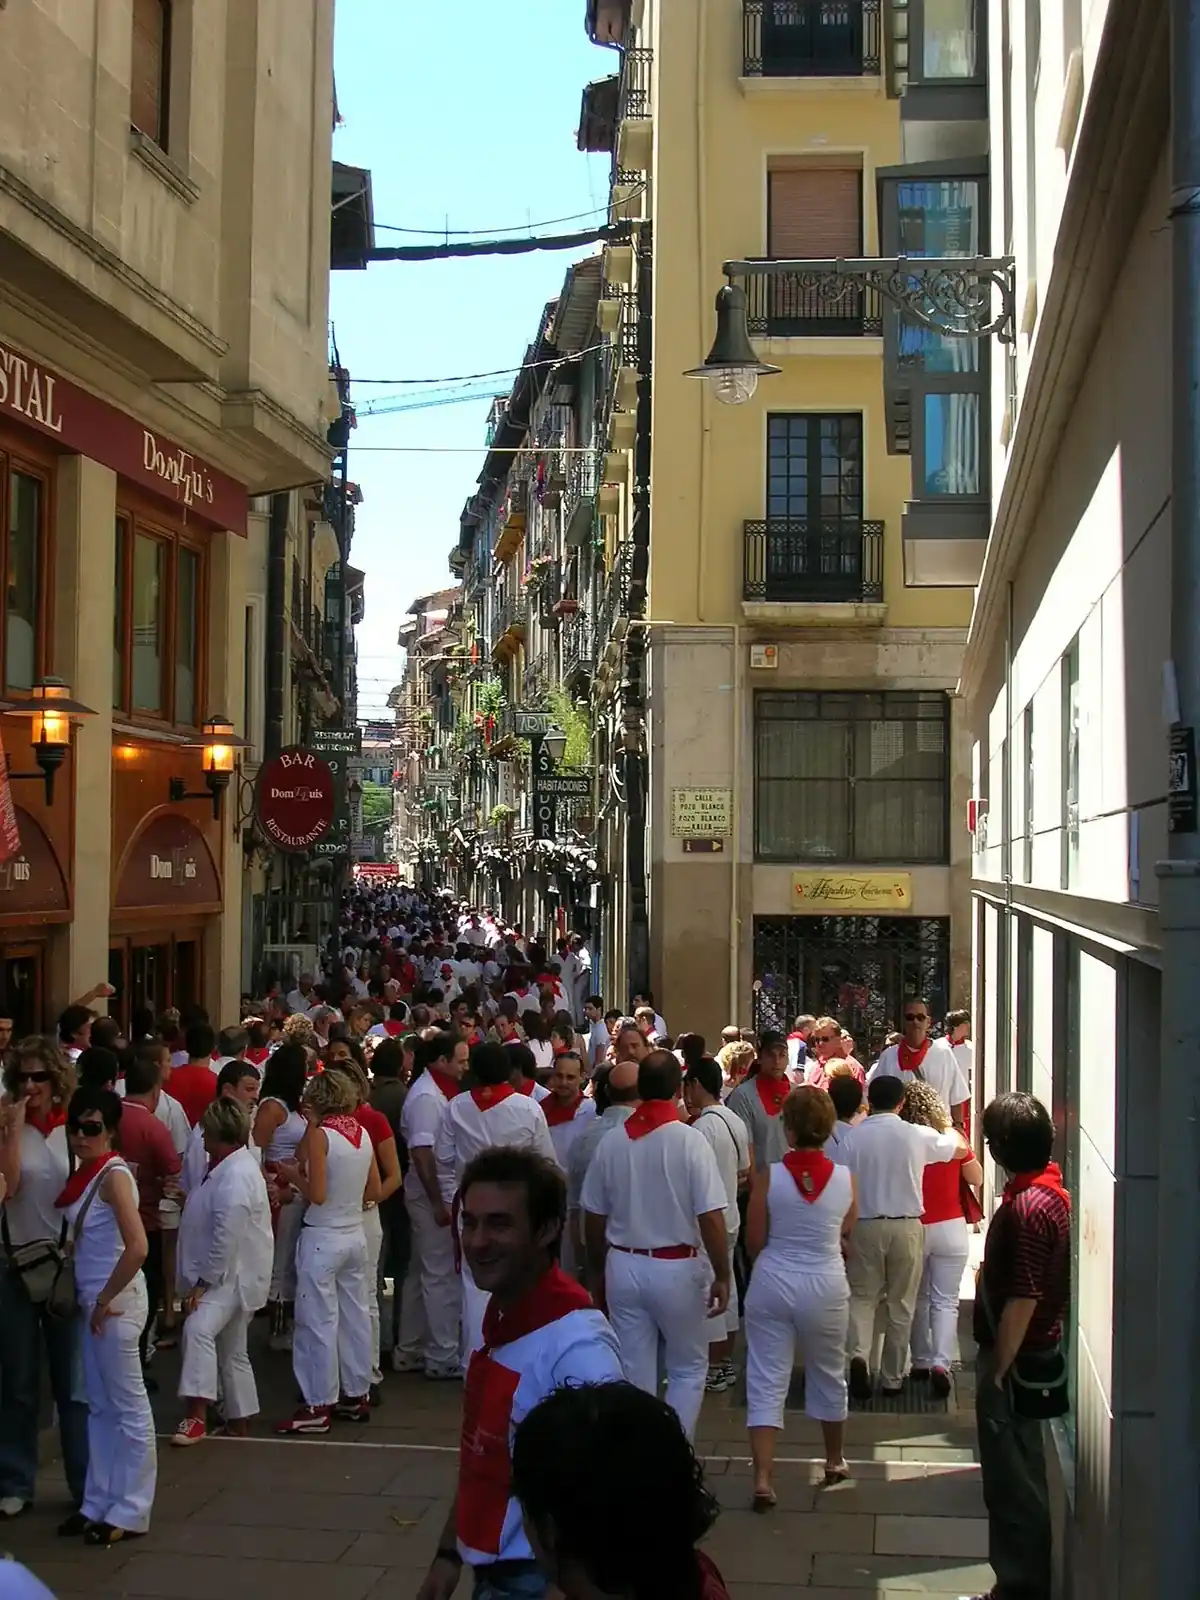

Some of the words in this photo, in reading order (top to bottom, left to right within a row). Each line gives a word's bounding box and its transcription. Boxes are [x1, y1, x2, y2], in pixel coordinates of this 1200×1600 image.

[280, 752, 315, 769] BAR
[537, 779, 588, 791] HABITACIONES
[266, 818, 328, 846] RESTAURANTE
